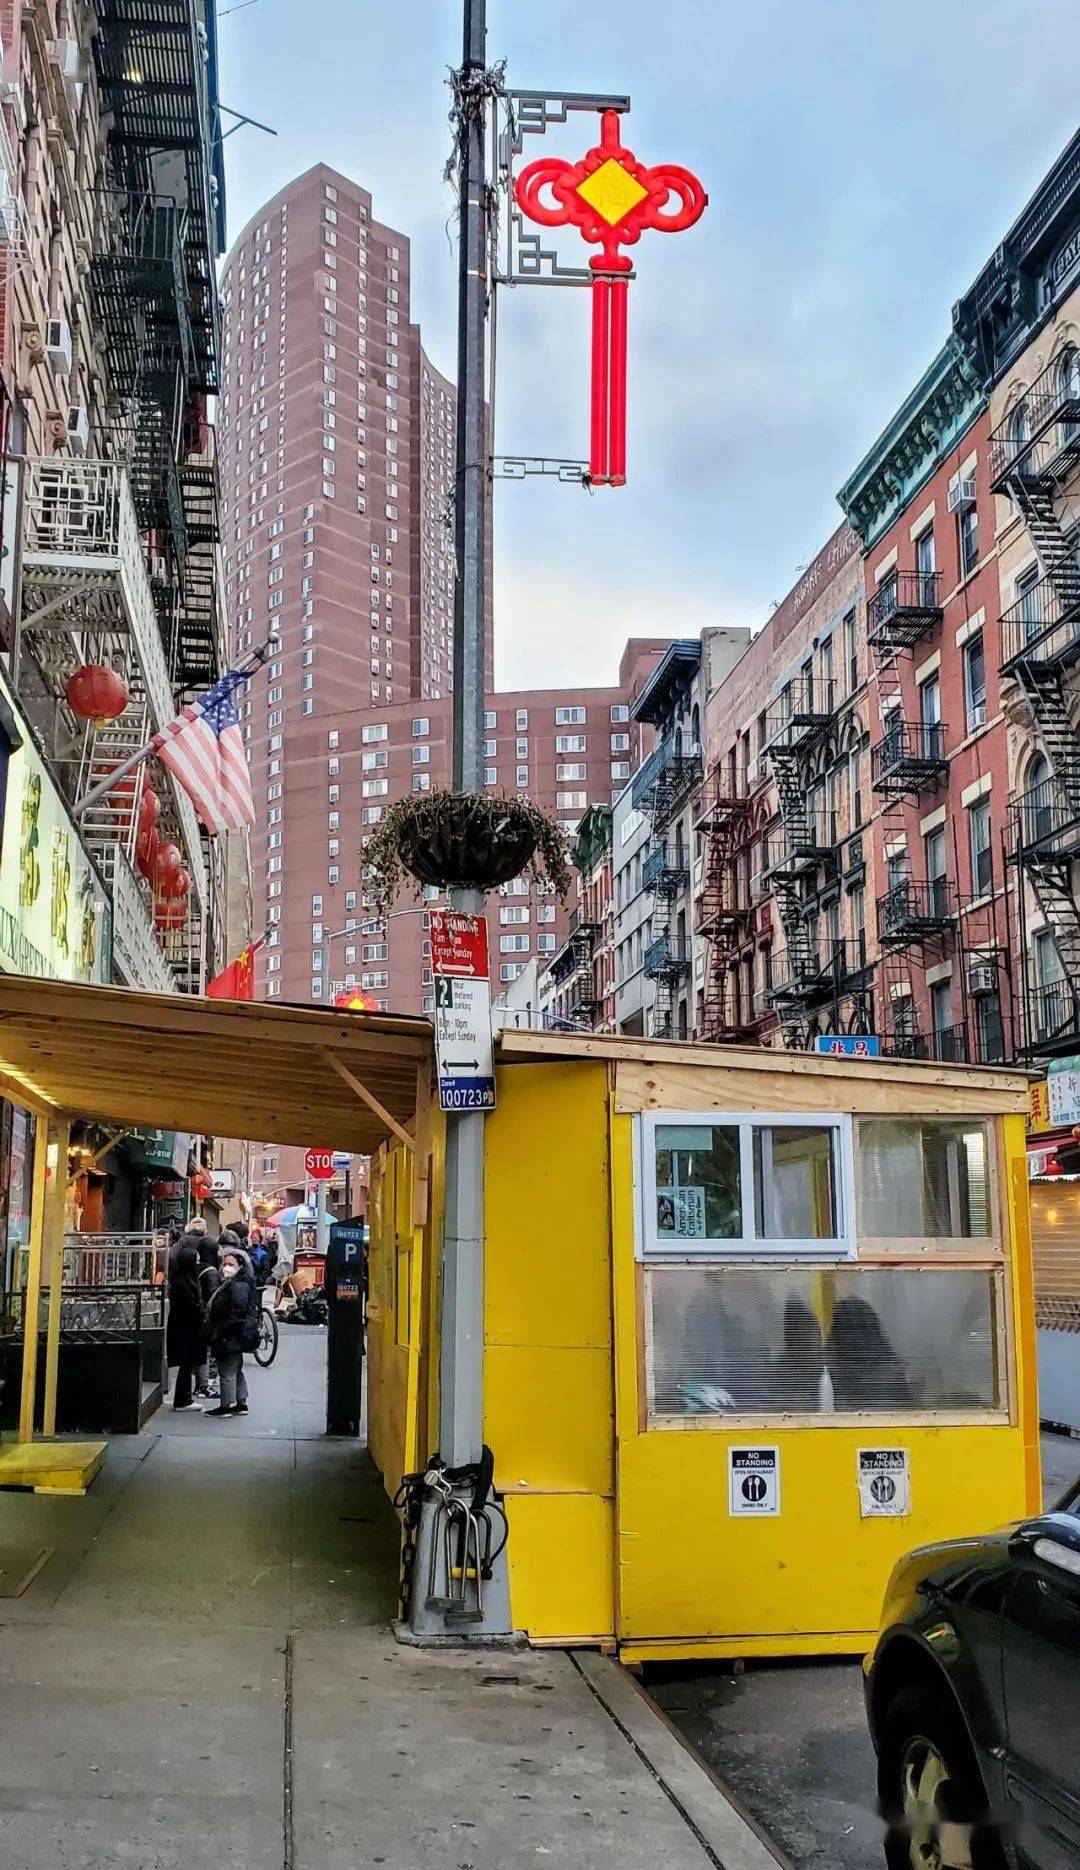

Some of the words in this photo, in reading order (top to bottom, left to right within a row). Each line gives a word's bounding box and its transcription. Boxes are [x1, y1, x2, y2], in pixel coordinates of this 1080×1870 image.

[439, 979, 449, 1006] 2
[458, 1031, 476, 1043] Sunday
[678, 1190, 686, 1236] American
[687, 1190, 695, 1236] Craftsman
[345, 1243, 357, 1261] P
